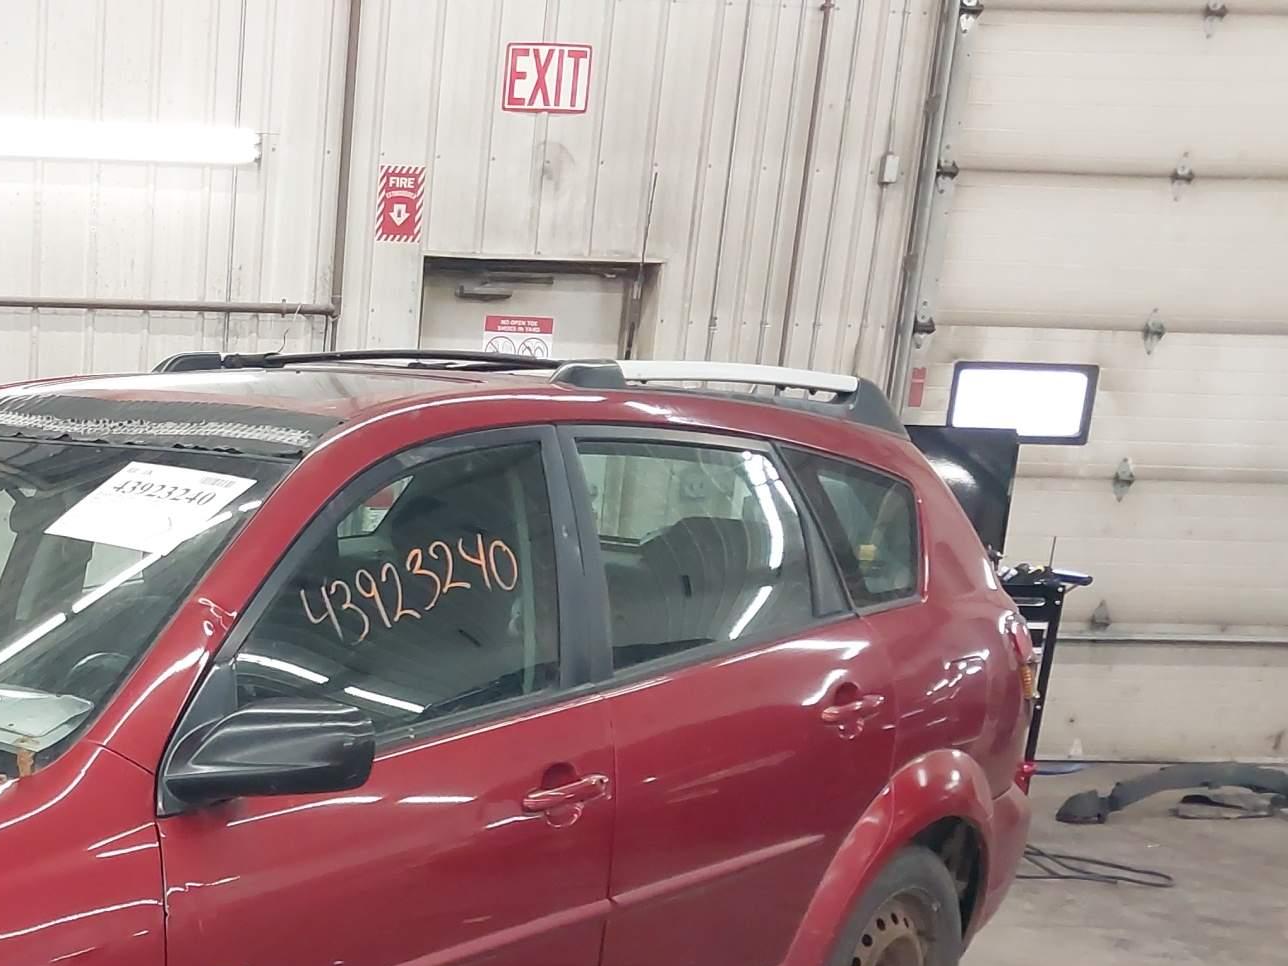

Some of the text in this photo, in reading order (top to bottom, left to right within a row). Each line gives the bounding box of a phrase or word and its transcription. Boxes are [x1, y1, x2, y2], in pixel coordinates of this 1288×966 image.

[506, 48, 589, 108] EXIT
[388, 176, 416, 189] FIRE
[112, 479, 217, 505] 43923240
[300, 533, 518, 646] 43923240
